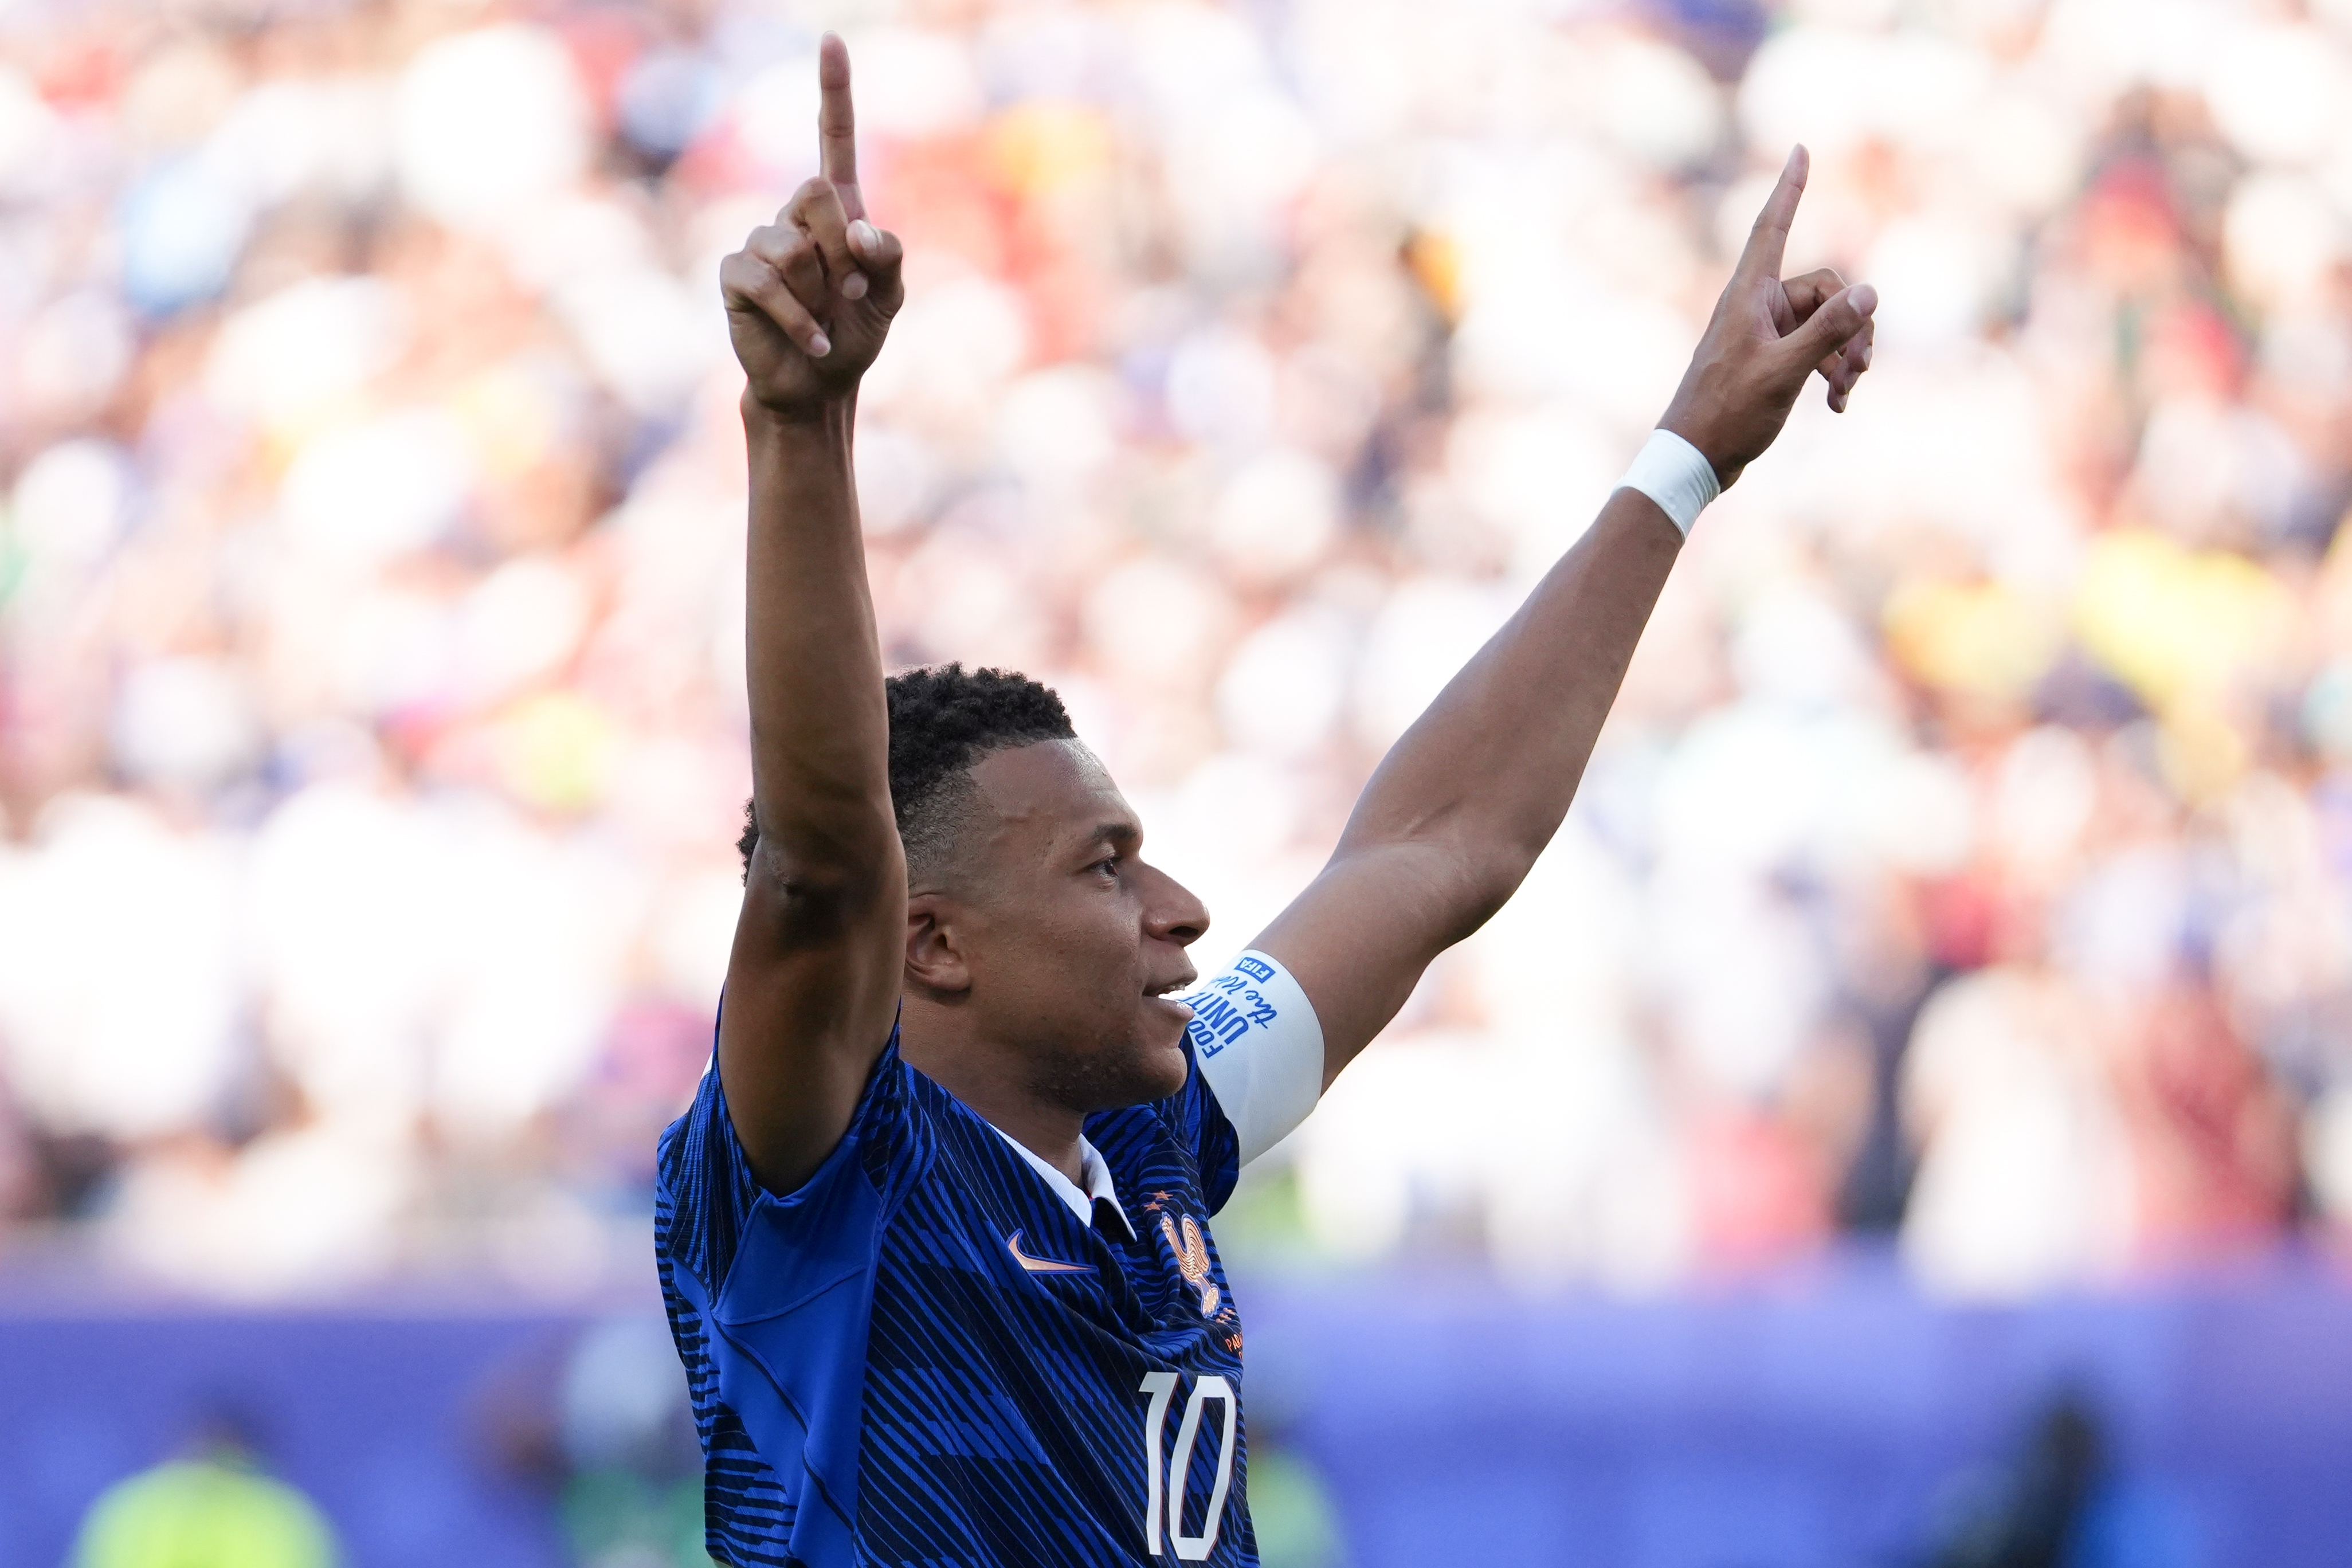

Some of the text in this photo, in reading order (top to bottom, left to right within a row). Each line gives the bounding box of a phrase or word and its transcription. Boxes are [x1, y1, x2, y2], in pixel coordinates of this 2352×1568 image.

[1240, 959, 1270, 979] FIFA
[1245, 990, 1277, 1029] the
[1187, 1020, 1224, 1059] FOO
[1139, 1371, 1237, 1561] 10
